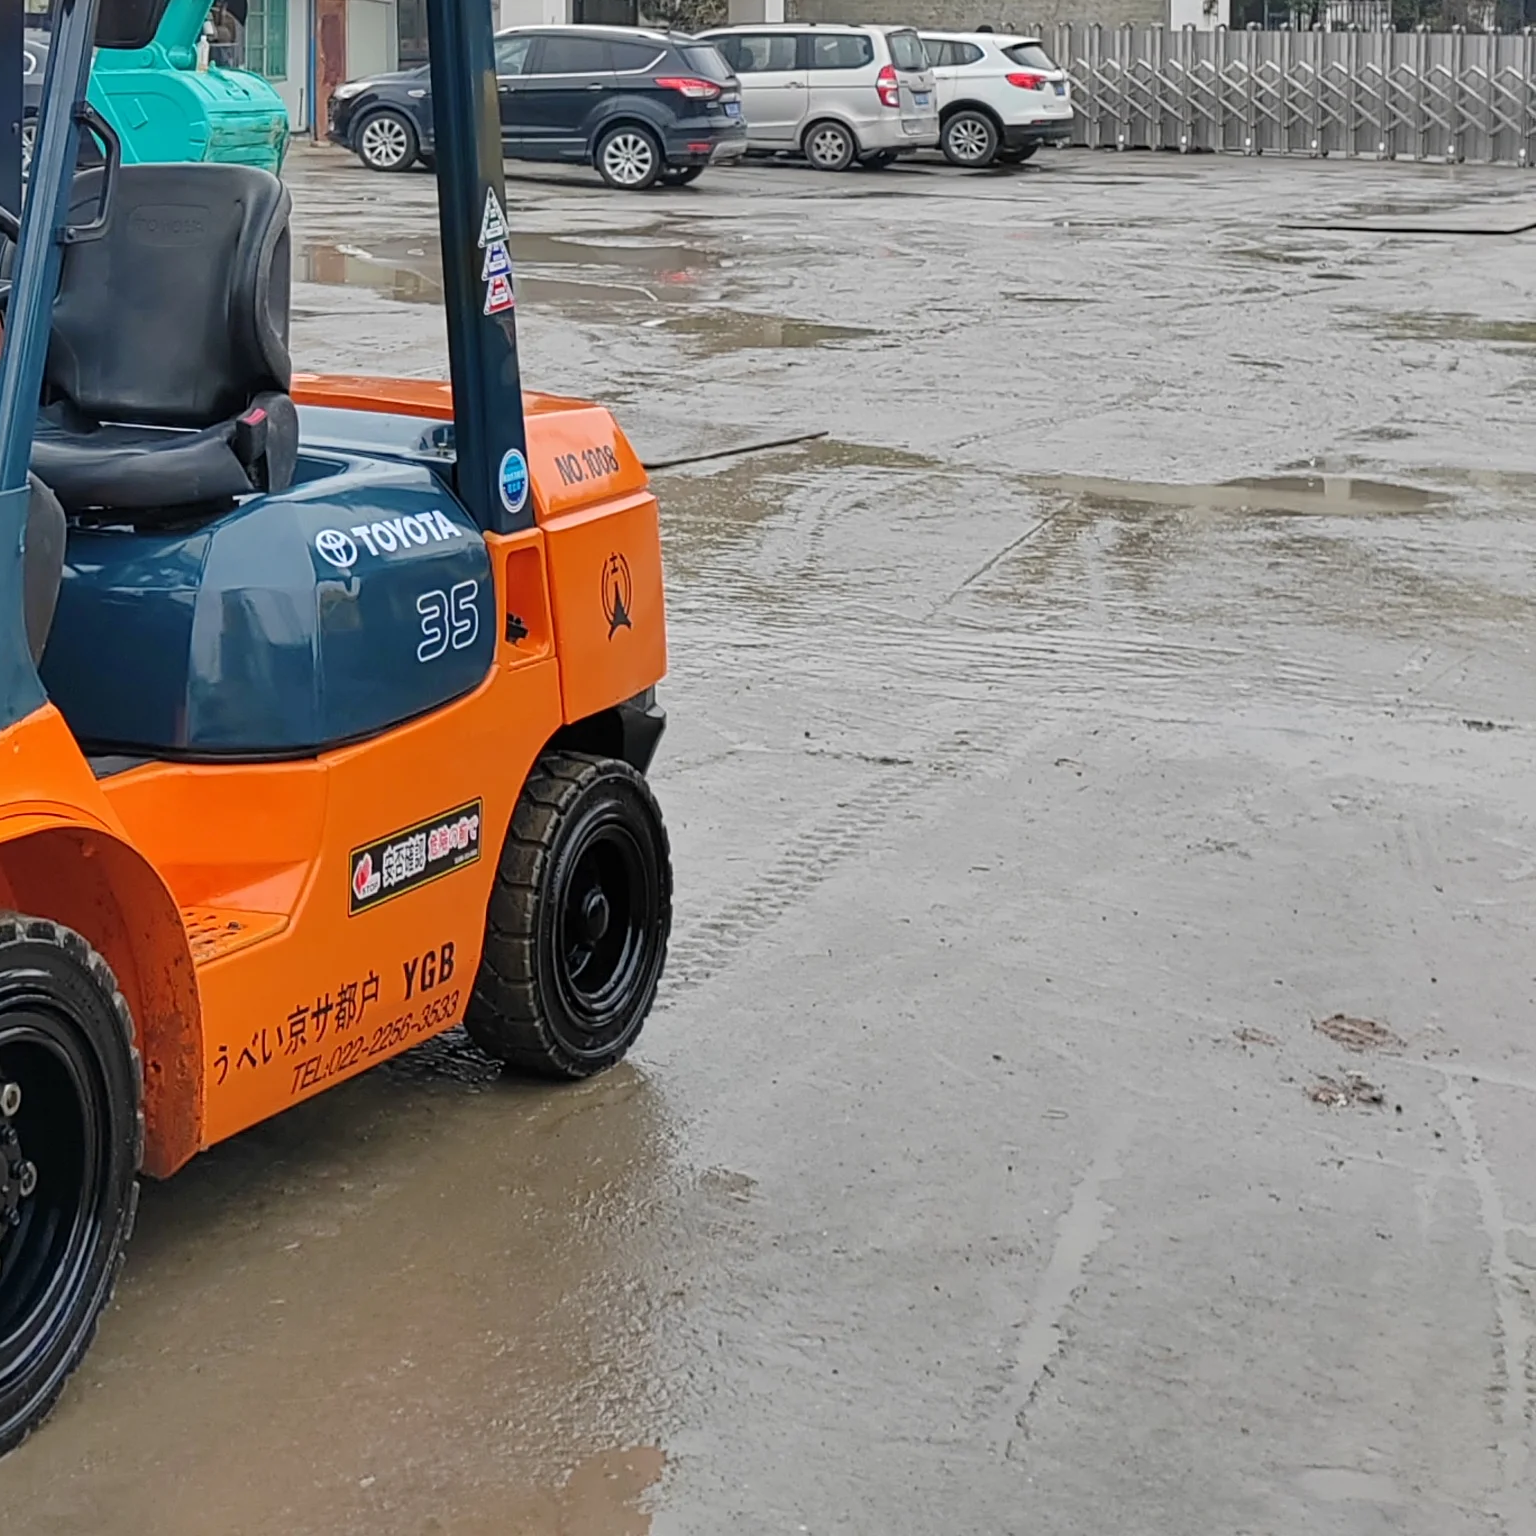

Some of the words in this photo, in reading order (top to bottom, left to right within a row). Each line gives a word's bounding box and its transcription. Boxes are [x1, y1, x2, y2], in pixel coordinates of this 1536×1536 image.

[555, 444, 620, 486] NO.1008
[351, 510, 462, 556] TOYOTA
[416, 579, 479, 662] 35
[402, 941, 455, 1001] YGB
